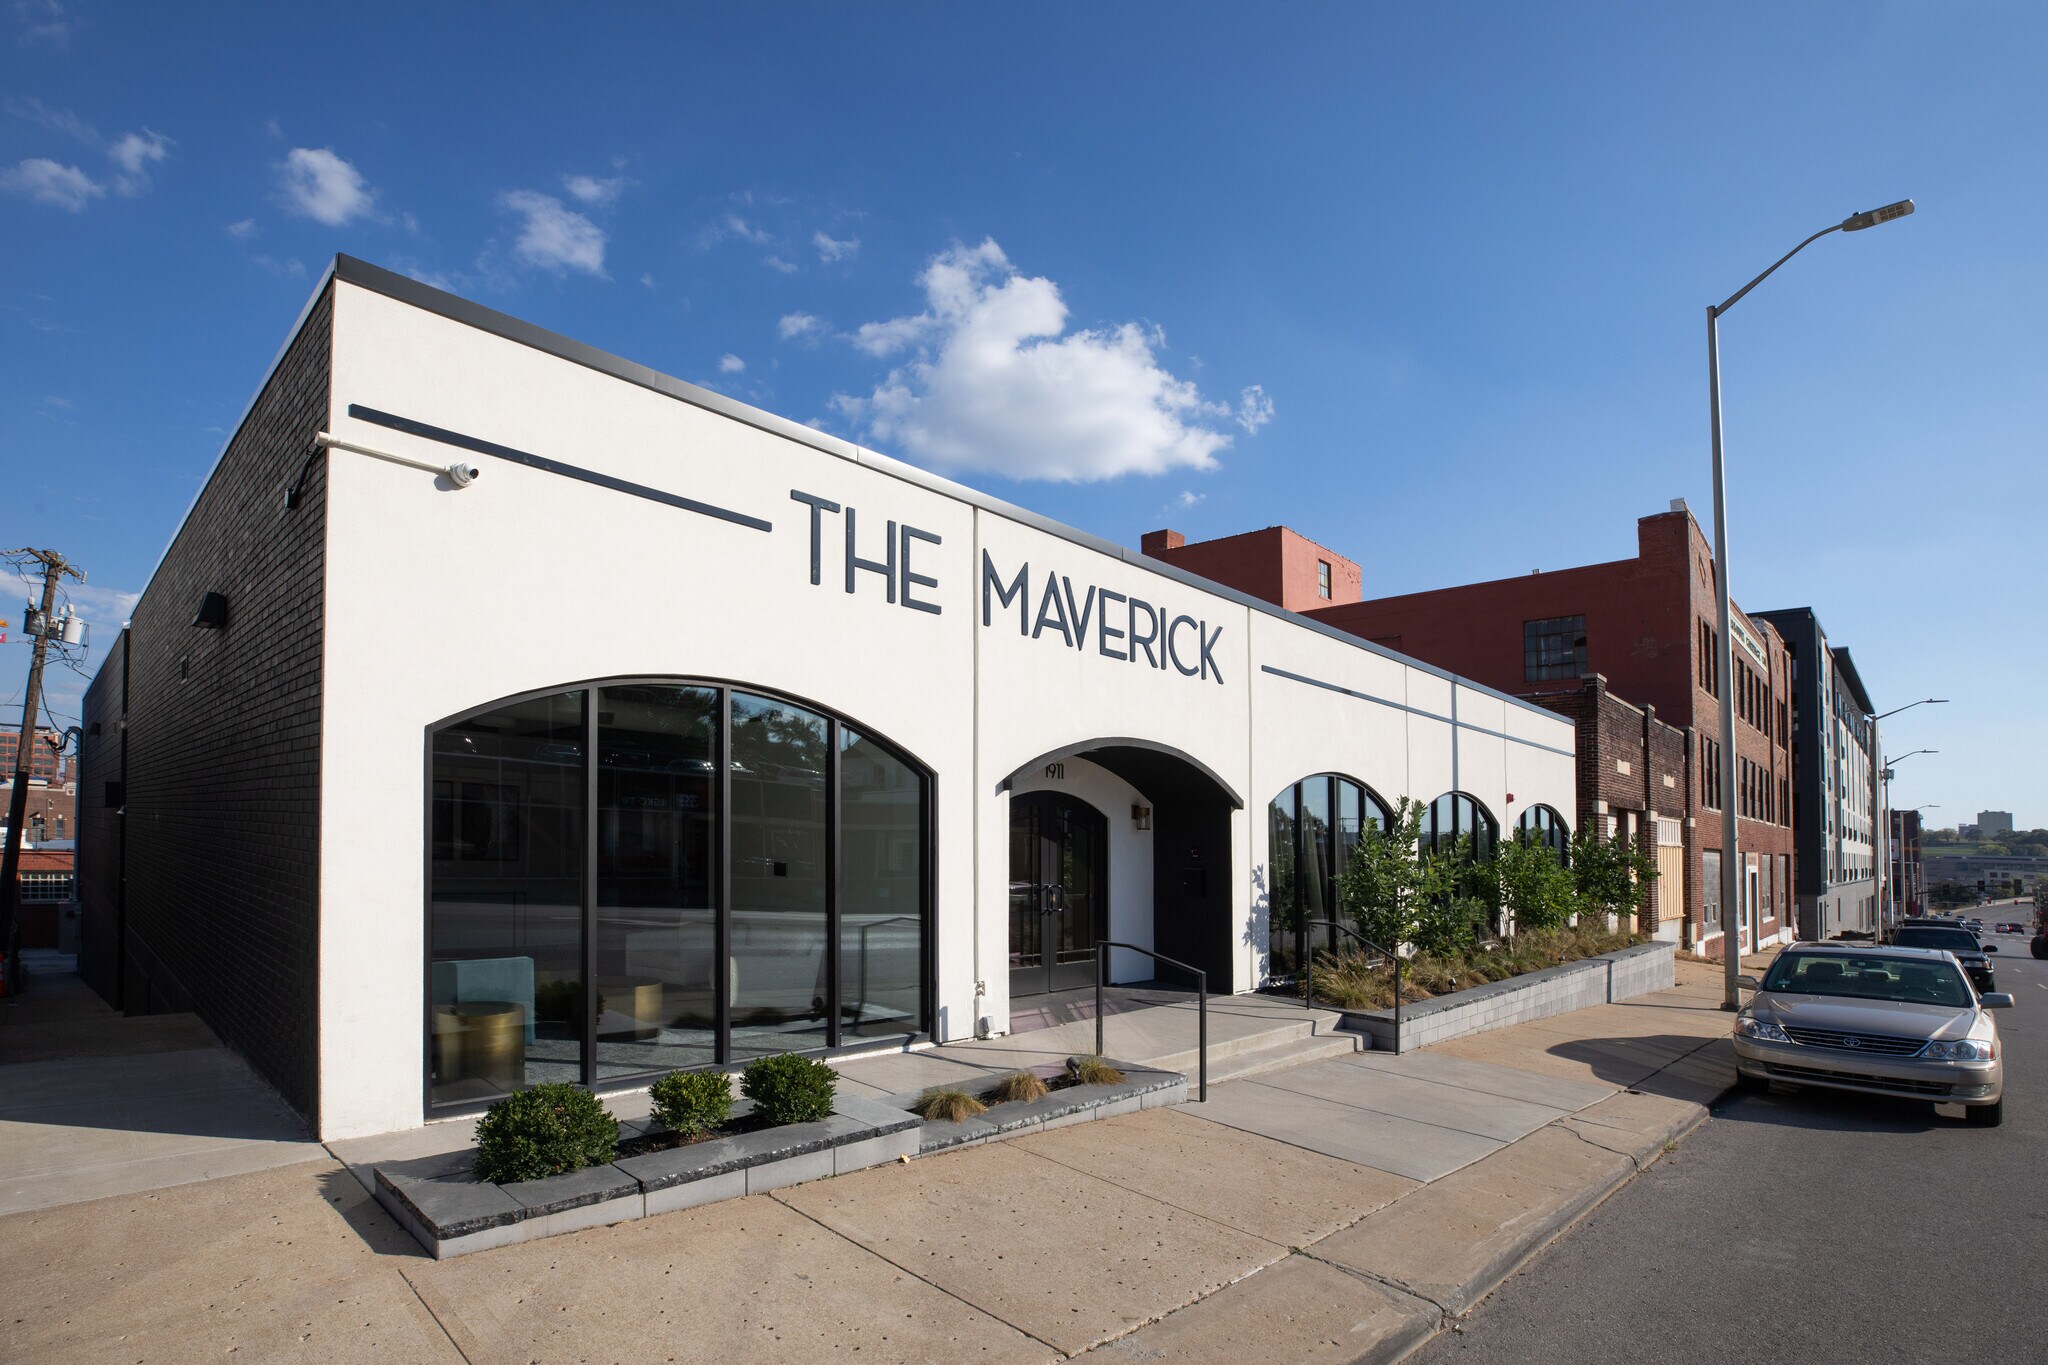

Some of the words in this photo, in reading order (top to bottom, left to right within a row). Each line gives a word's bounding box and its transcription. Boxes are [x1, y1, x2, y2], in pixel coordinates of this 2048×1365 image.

[790, 489, 942, 616] THE
[983, 548, 1224, 685] MAVERICK
[1045, 763, 1064, 780] 1911
